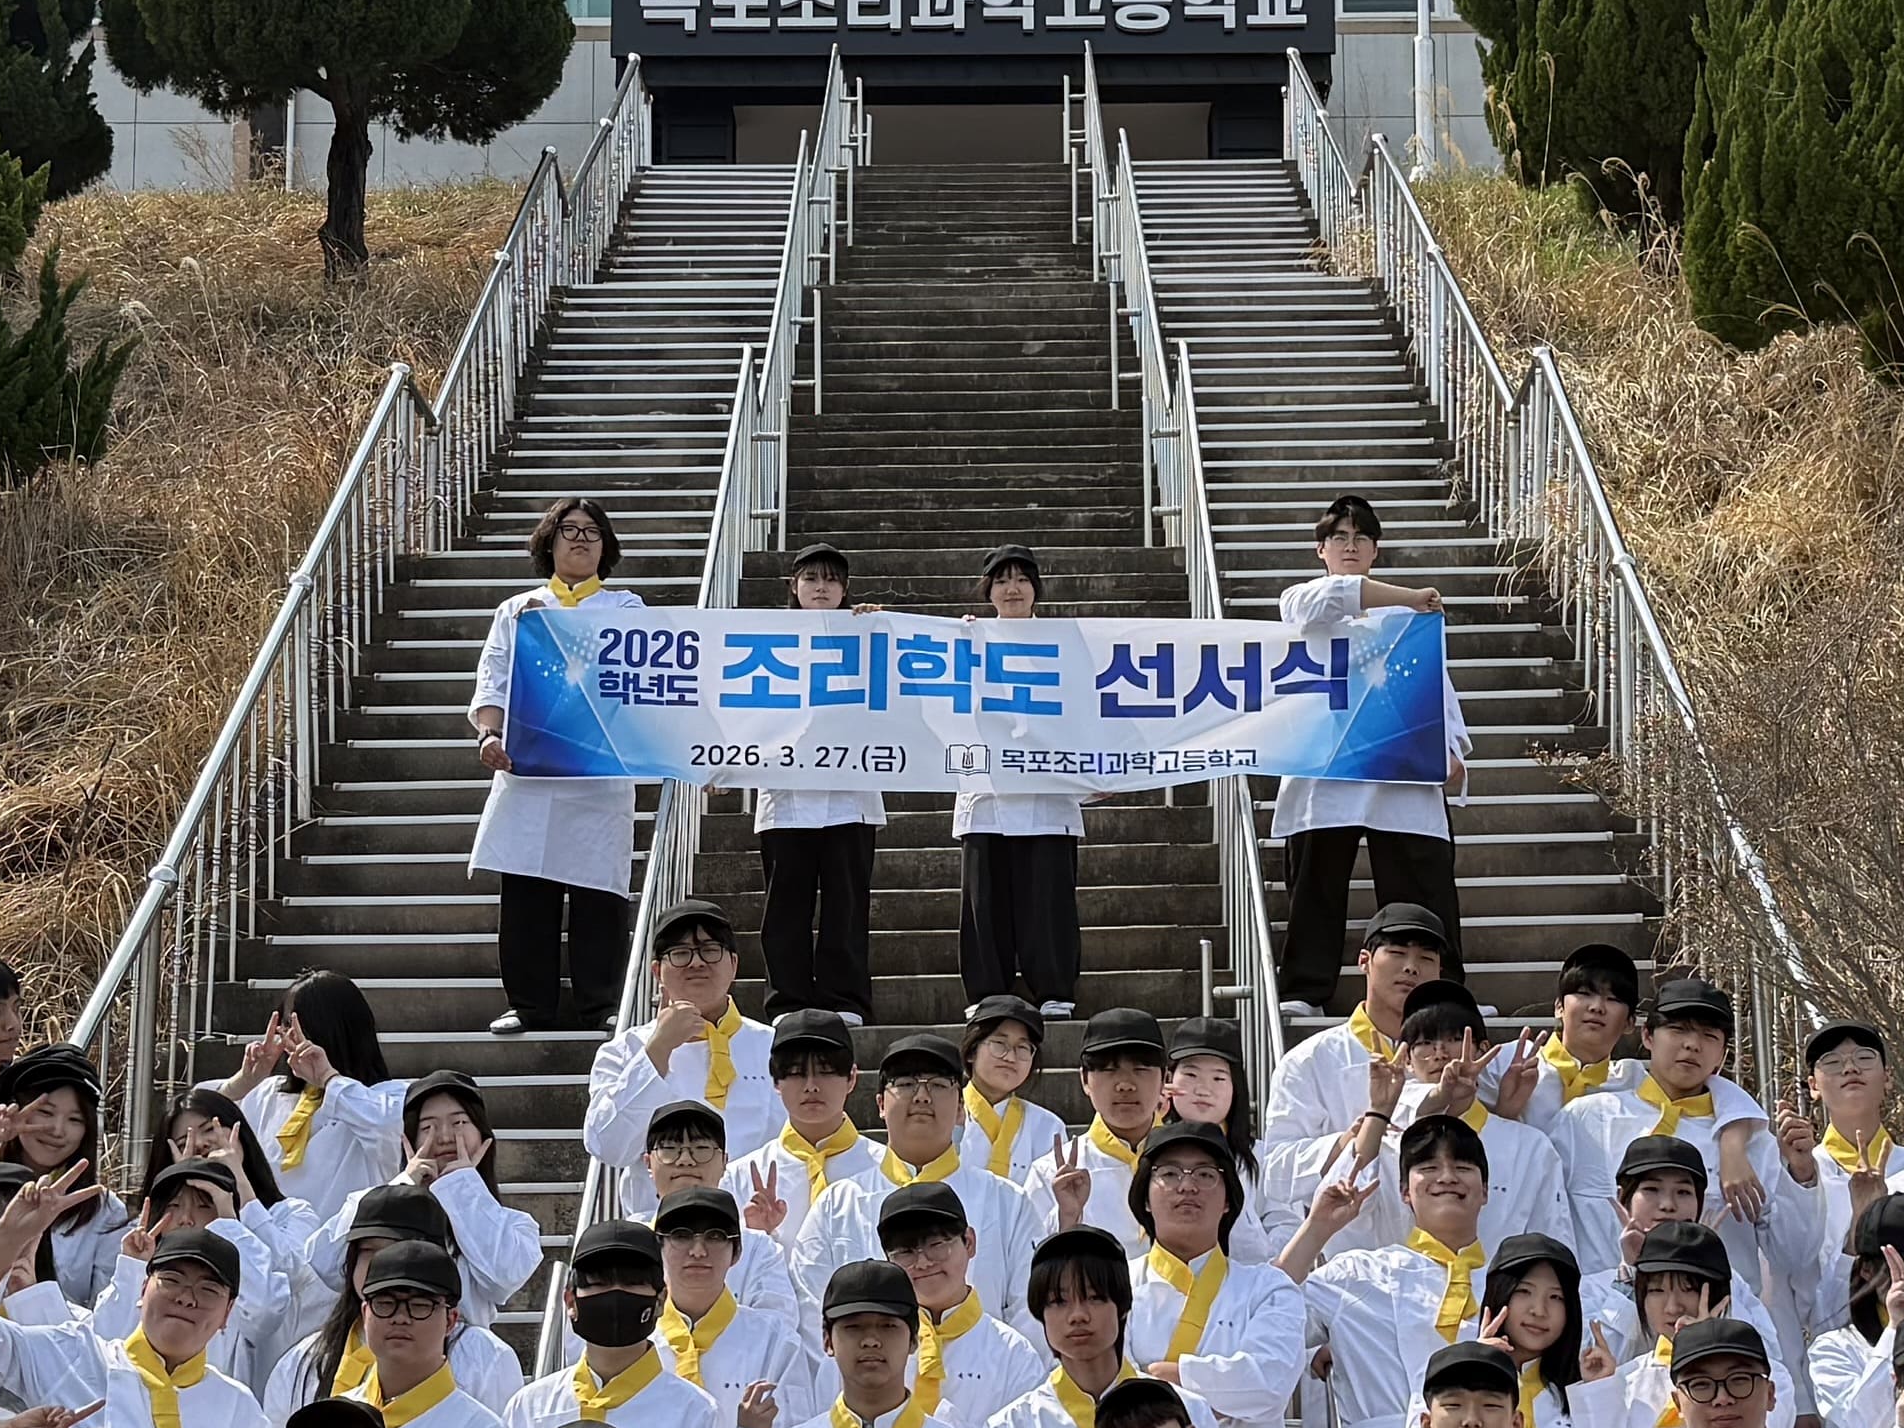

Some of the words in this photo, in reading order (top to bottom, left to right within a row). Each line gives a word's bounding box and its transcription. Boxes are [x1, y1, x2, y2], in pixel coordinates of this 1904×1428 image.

[597, 627, 701, 670] 2026
[598, 670, 699, 707] 학년도
[718, 631, 1064, 716] 조리학도
[1095, 637, 1350, 719] 선서식
[690, 744, 769, 768] 2026.
[779, 745, 805, 769] 3.
[814, 745, 908, 774] 27.(금)
[1000, 748, 1260, 777] 목포조리과학고등학교
